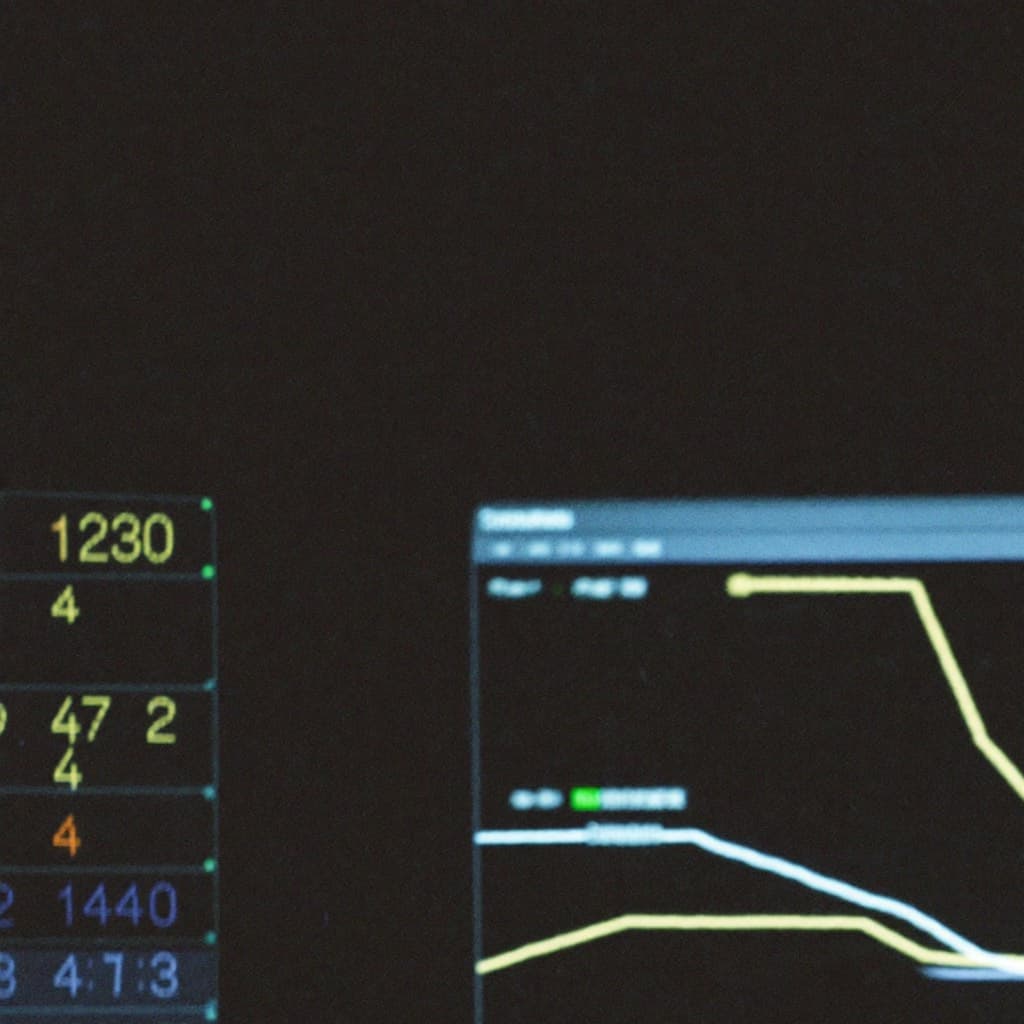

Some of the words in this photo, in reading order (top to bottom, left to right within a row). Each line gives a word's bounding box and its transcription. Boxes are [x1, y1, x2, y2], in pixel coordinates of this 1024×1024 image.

[50, 511, 175, 565] 1230
[50, 583, 80, 625] 4
[50, 694, 112, 745] 47
[146, 694, 177, 745] 2
[52, 745, 83, 792] 4
[52, 813, 81, 858] 4
[58, 881, 179, 928] 1440
